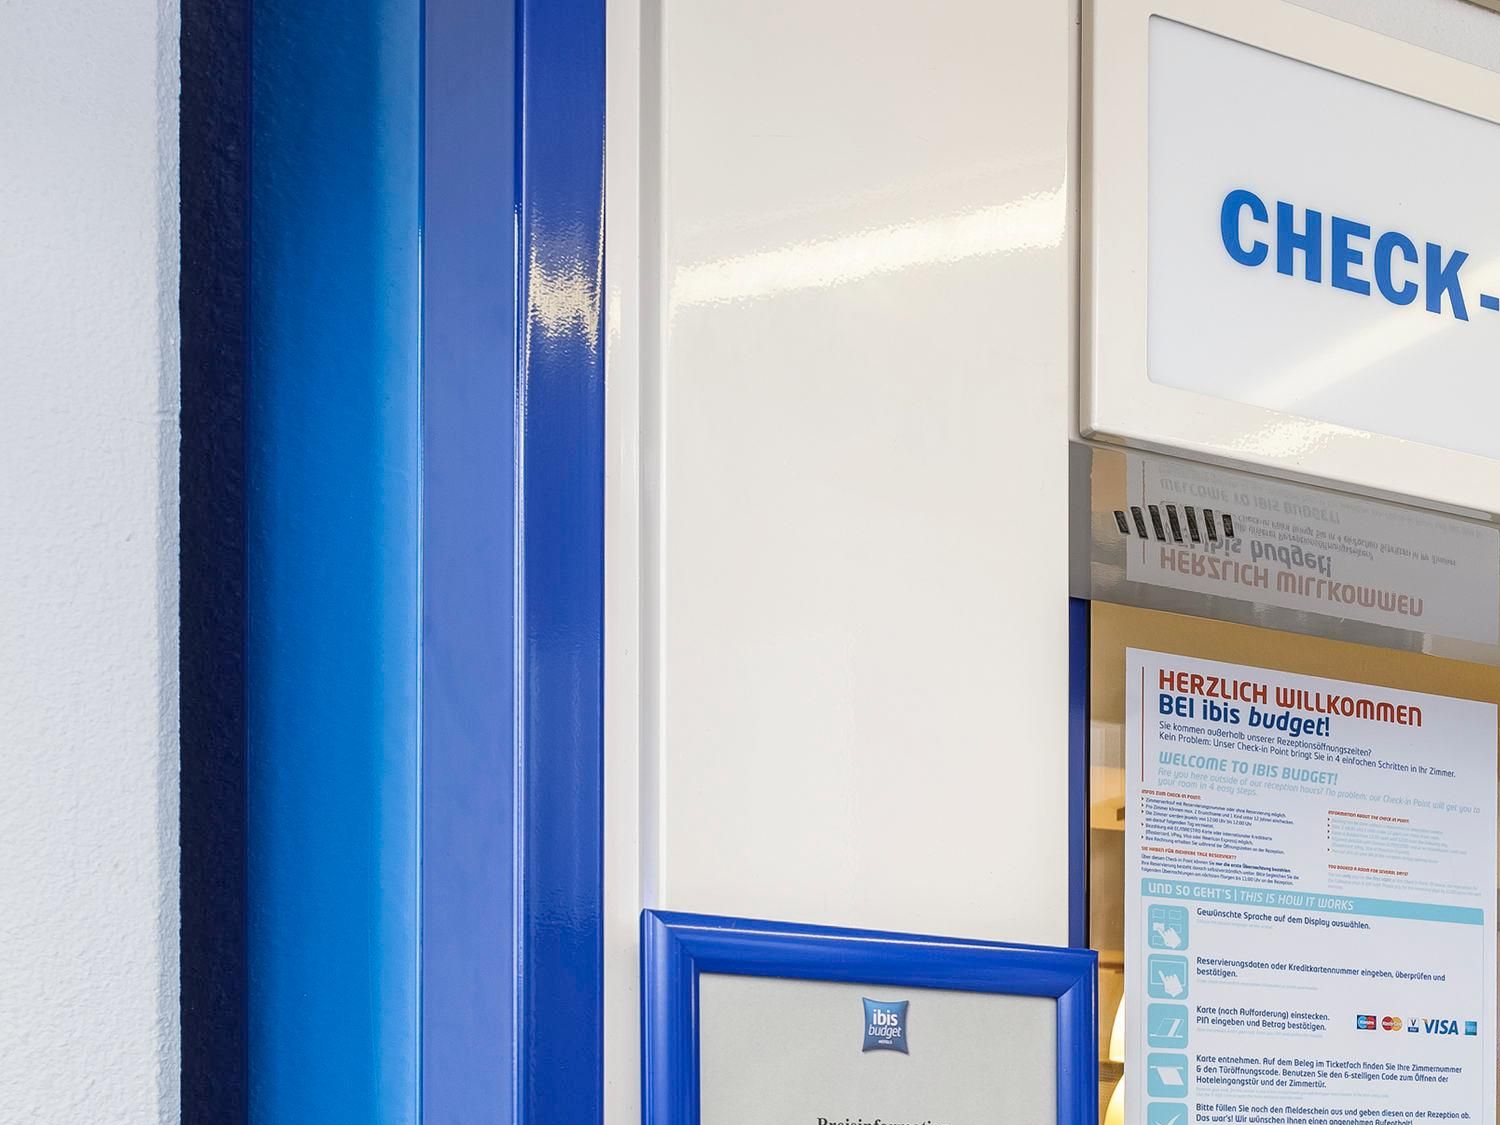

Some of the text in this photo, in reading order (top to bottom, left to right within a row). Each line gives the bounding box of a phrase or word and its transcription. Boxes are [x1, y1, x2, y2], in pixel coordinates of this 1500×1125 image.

[1159, 670, 1422, 725] HERZLICH WILLKOMMEN
[1159, 693, 1329, 736] BEI ibis budget!
[1159, 720, 1372, 755] Sie kommen außerhalb unserer Rezeptionsöffnungszeiten?
[1159, 731, 1176, 740] Kein
[1178, 733, 1211, 745] Problem:
[1212, 738, 1235, 748] Unser
[1236, 741, 1269, 752] Check-in
[1269, 745, 1289, 756] Point
[1290, 747, 1312, 760] bringt
[1313, 751, 1325, 760] Sie
[1326, 753, 1333, 761] in
[1334, 753, 1341, 762] 4
[1340, 753, 1376, 766] einfachen
[1377, 760, 1409, 771] Schritten
[1410, 764, 1417, 772] in
[1159, 752, 1338, 784] WELCOME TO IBIS BUDGET!
[1148, 882, 1353, 910] UND SO GEHT'S THIS IS HOW IT WORKS
[1196, 907, 1242, 918] Gewünschte
[1243, 911, 1272, 921] Sprache
[1273, 914, 1285, 922] auf
[1286, 915, 1302, 923] dem
[1304, 916, 1330, 927] Display
[1196, 956, 1269, 969] Reservierungsdaten
[1270, 962, 1287, 970] oder
[1288, 963, 1359, 974] Kreditkartennummer
[1394, 971, 1432, 980] überprüfen
[873, 1009, 898, 1026] ibis
[1196, 1015, 1209, 1023] PIN
[1210, 1017, 1245, 1026] eingeben
[1261, 1019, 1286, 1029] Betrag
[1424, 1019, 1459, 1034] VISA
[868, 1024, 902, 1039] budget
